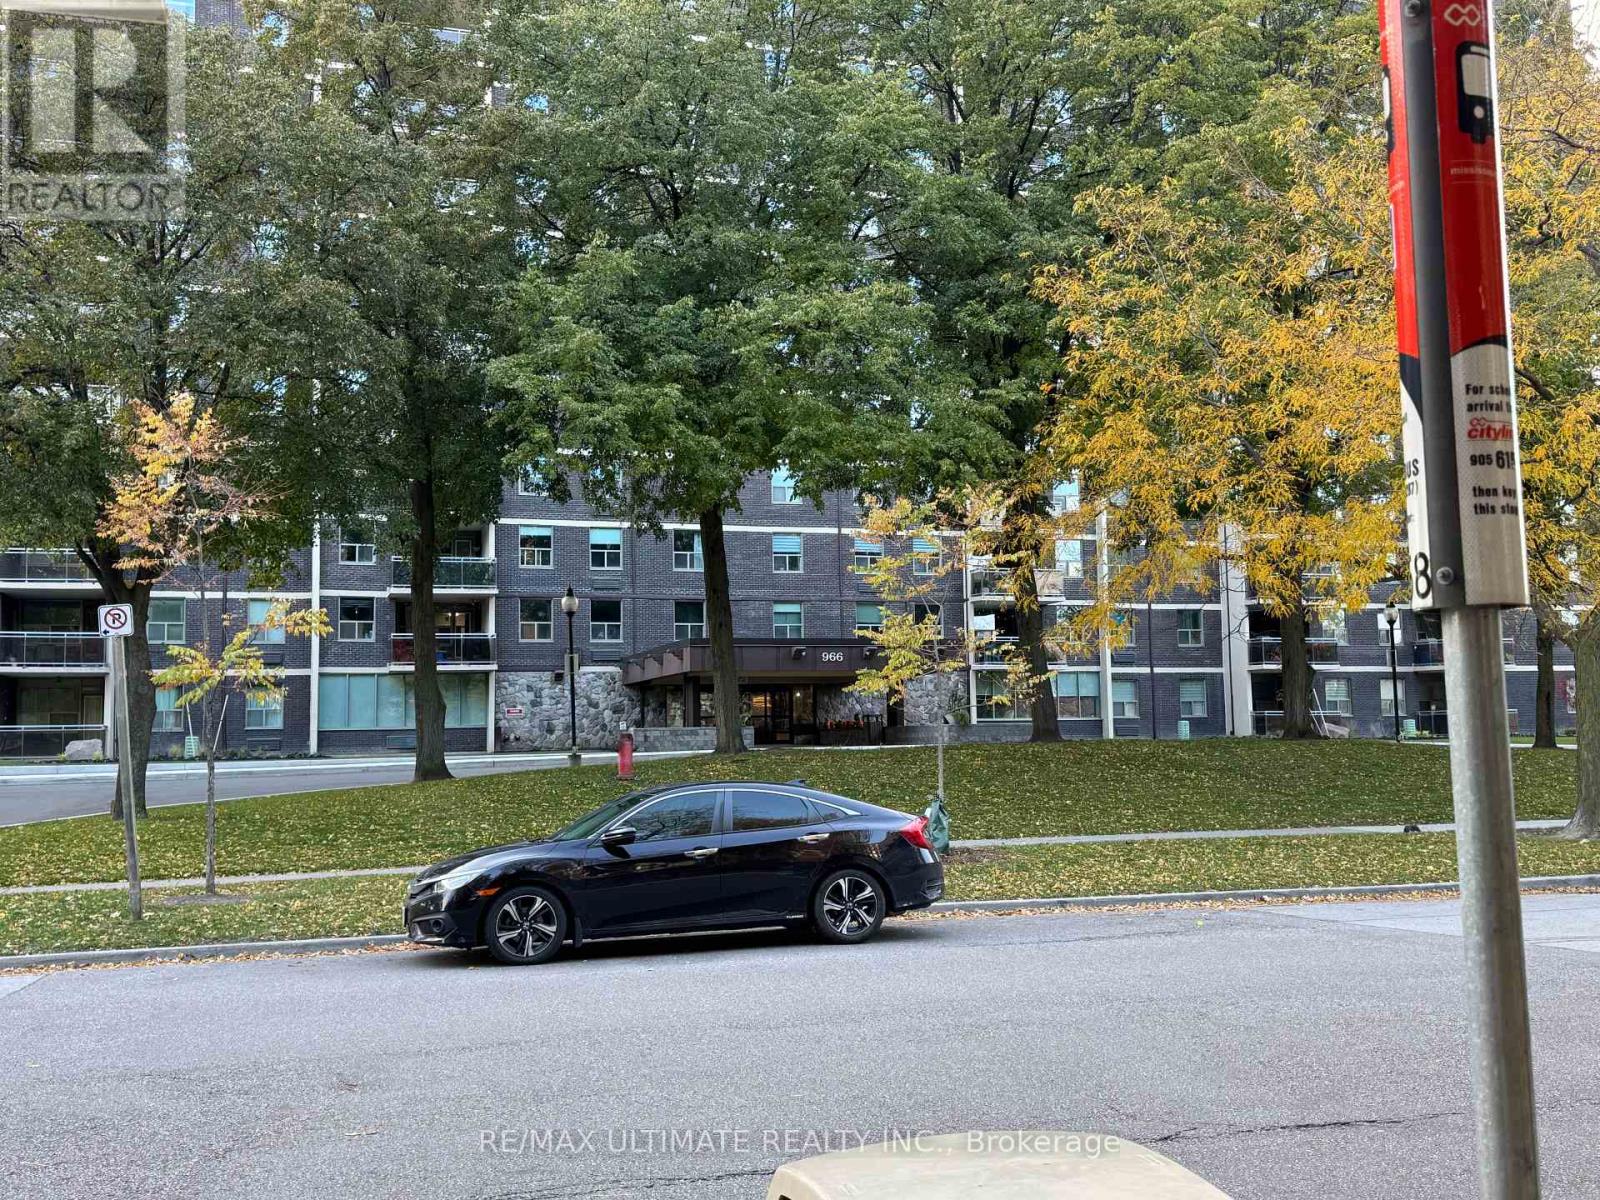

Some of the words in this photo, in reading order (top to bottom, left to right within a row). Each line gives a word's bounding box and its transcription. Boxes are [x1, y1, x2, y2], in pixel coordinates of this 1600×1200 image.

[1465, 384, 1484, 395] For
[1467, 400, 1503, 412] arrival
[1470, 454, 1493, 466] 905
[1472, 486, 1498, 498] then
[1474, 503, 1496, 515] this
[821, 651, 844, 662] 966
